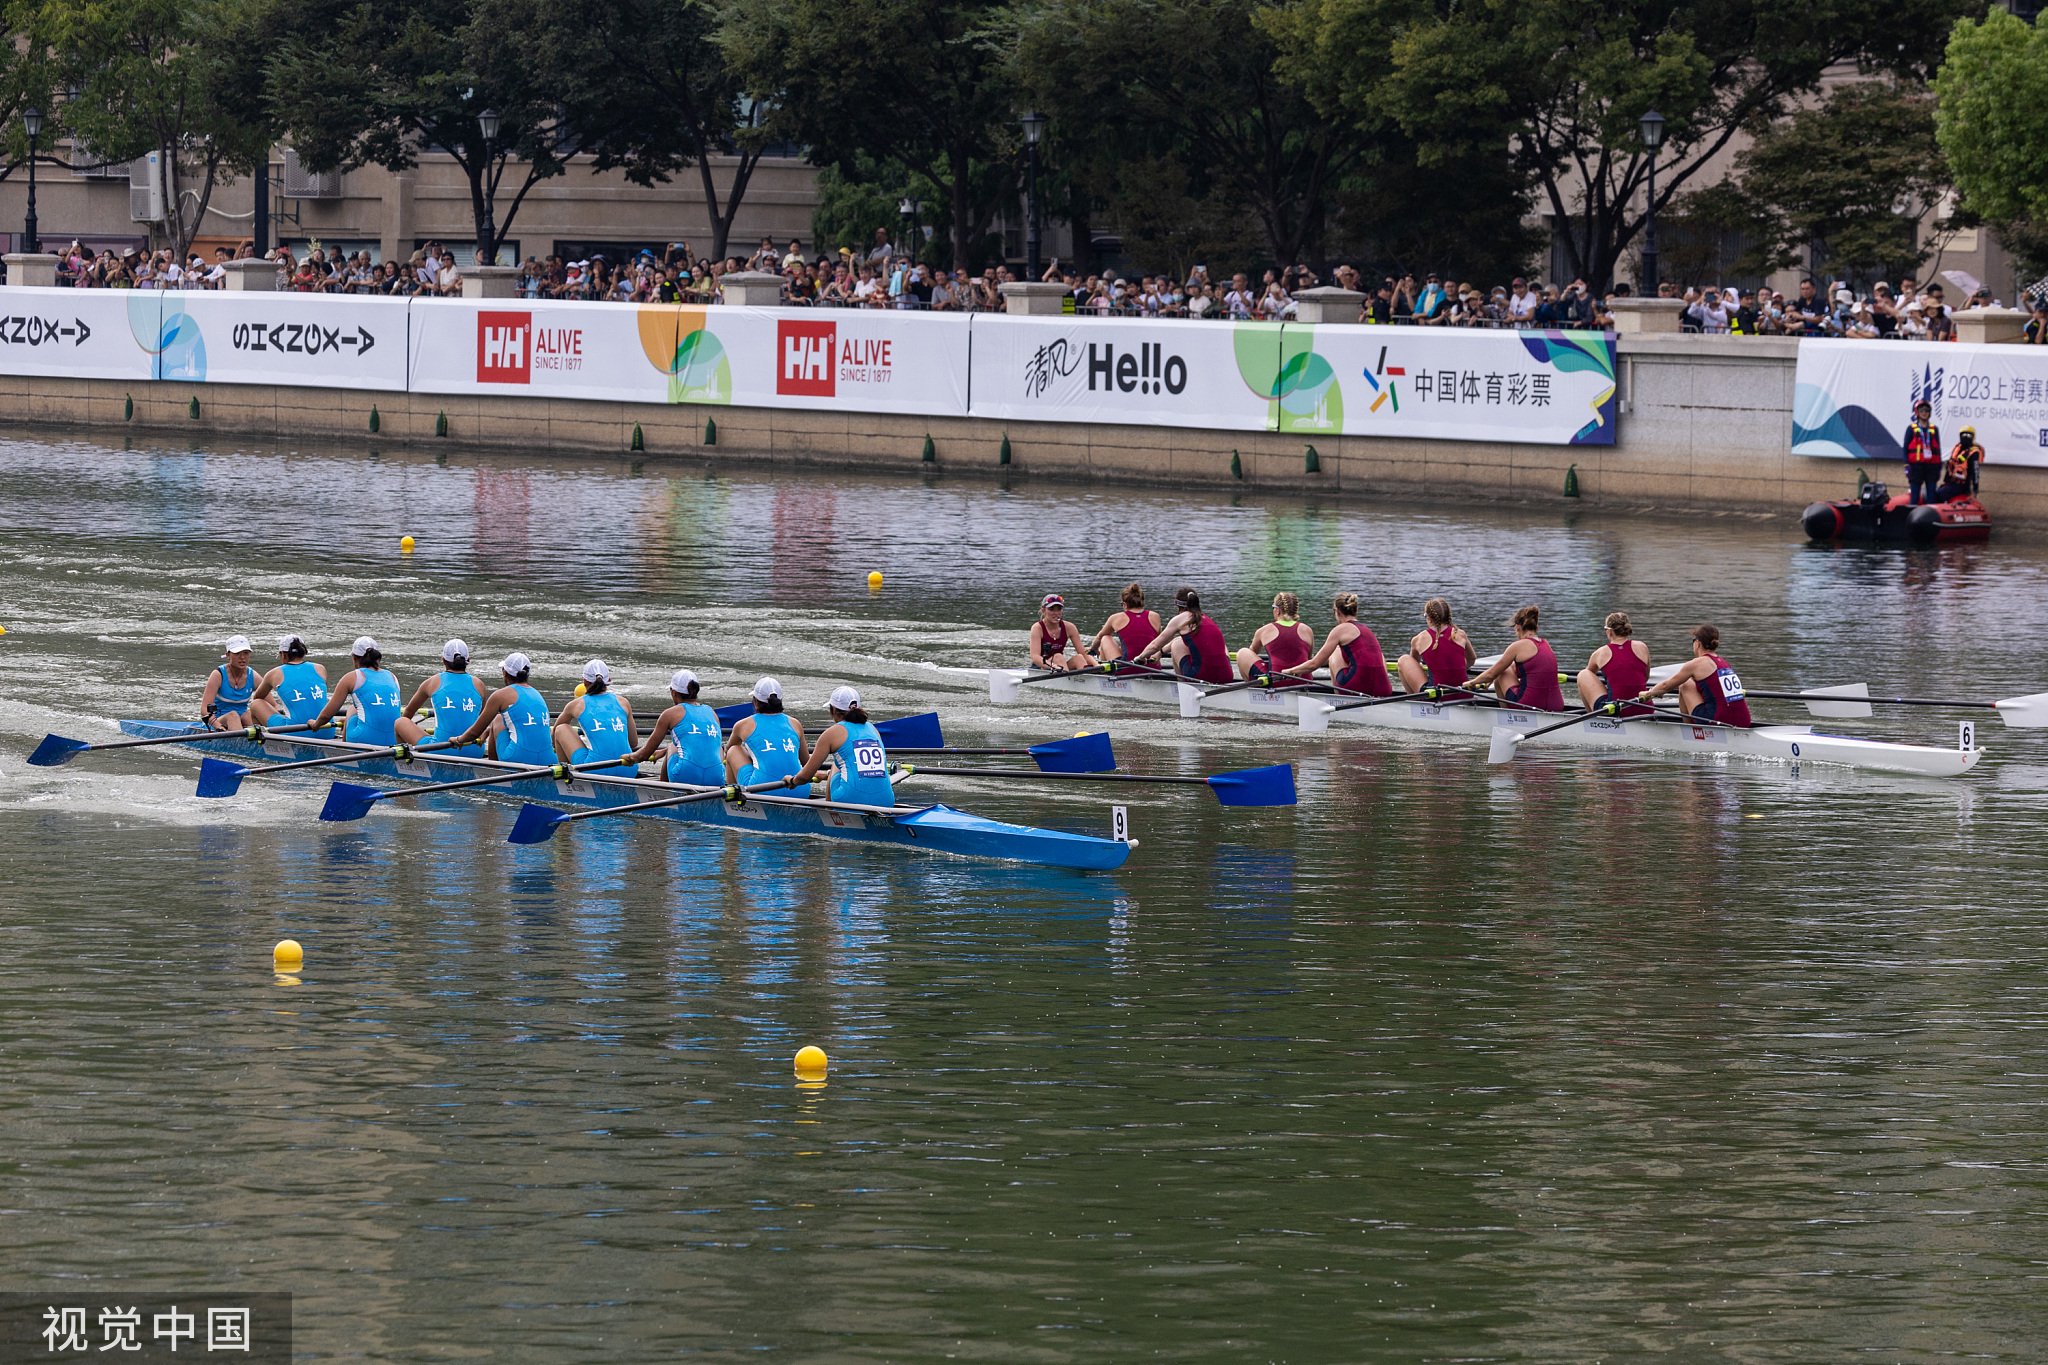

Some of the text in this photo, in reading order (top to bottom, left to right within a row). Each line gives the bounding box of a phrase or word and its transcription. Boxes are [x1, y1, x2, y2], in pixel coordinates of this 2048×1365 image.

[536, 328, 583, 355] ALIVE
[841, 339, 892, 366] ALIVE
[1415, 368, 1551, 407] 中国体育彩票
[1947, 406, 1972, 418] HEAD
[1974, 406, 1987, 418] OF
[1989, 407, 2037, 420] SHANGHAI
[1723, 676, 1741, 692] 06
[291, 684, 325, 702] 上海
[370, 692, 400, 708] 上海
[441, 696, 476, 713] 上海
[590, 716, 625, 733] 上海
[687, 723, 719, 738] 上海
[1963, 726, 1970, 745] 6
[760, 737, 796, 753] 上海
[859, 749, 882, 765] 09
[1116, 812, 1124, 835] 9
